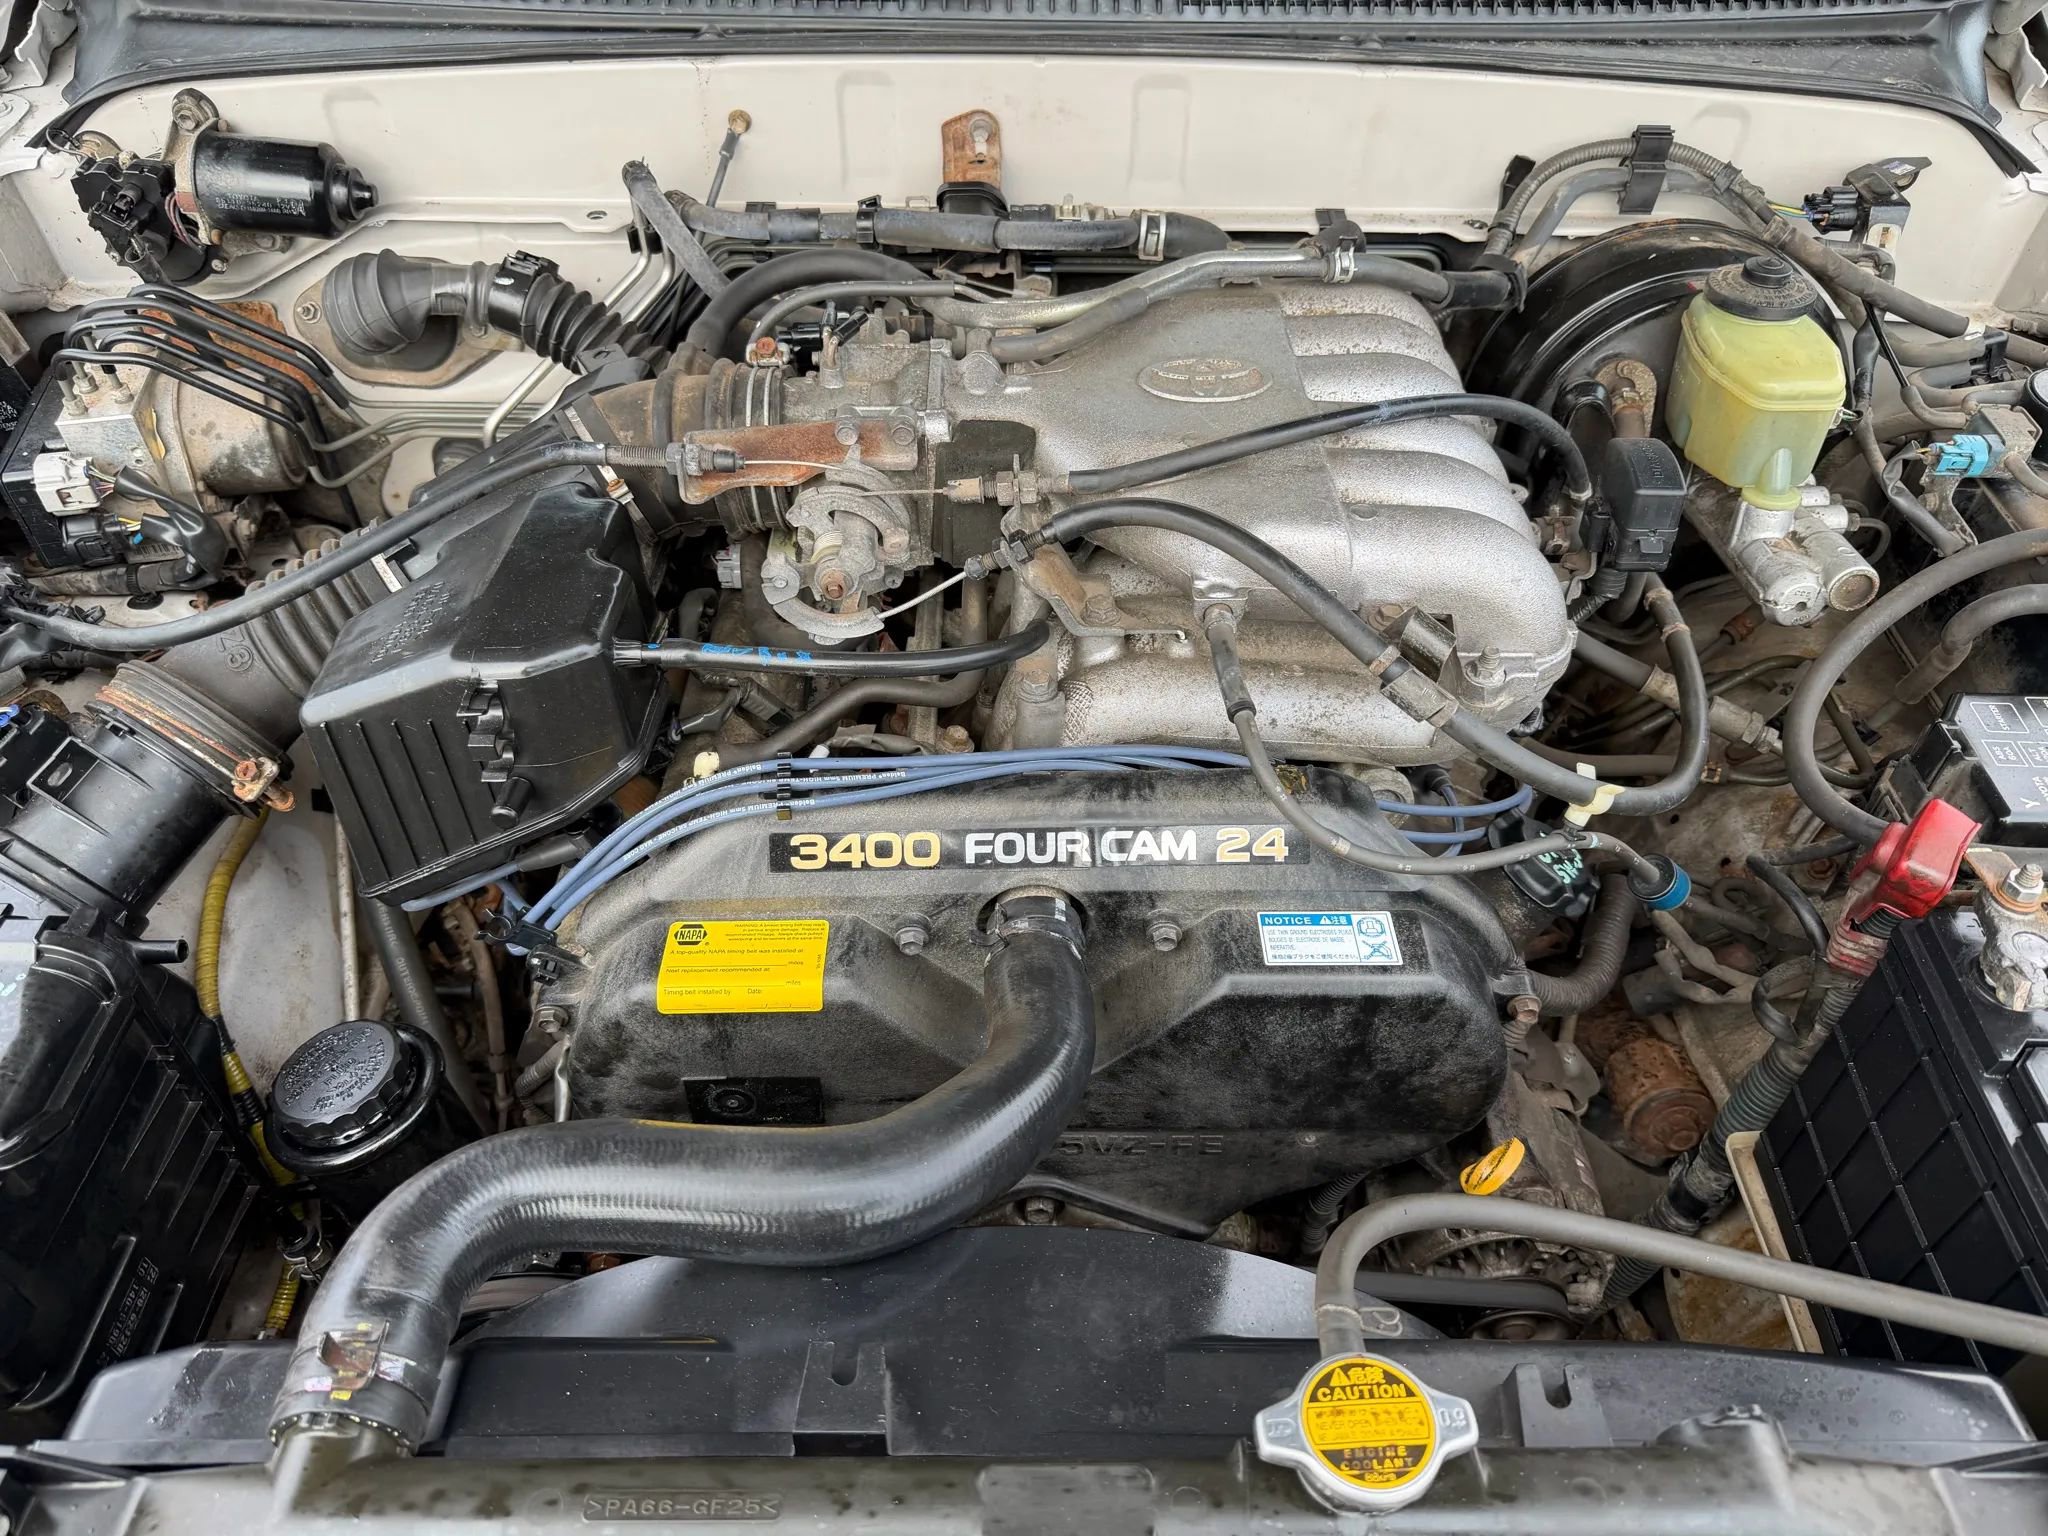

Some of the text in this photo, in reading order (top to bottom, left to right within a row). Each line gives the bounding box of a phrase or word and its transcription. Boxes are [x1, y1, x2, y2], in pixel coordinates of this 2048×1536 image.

[1989, 704, 2010, 731] STARTER
[1992, 745, 2007, 761] ABS
[2003, 746, 2017, 761] 60A
[688, 810, 728, 826] HIGH-TEMP
[790, 827, 1287, 869] 3400 FOUR CAM 24
[1264, 916, 1312, 925] NOTICE
[679, 929, 703, 941] NAPA
[1056, 1134, 1225, 1156] 5VZ-FE
[1316, 1383, 1407, 1402] CAUTION
[1343, 1446, 1408, 1459] ENGINE
[1340, 1457, 1413, 1471] COOLANT
